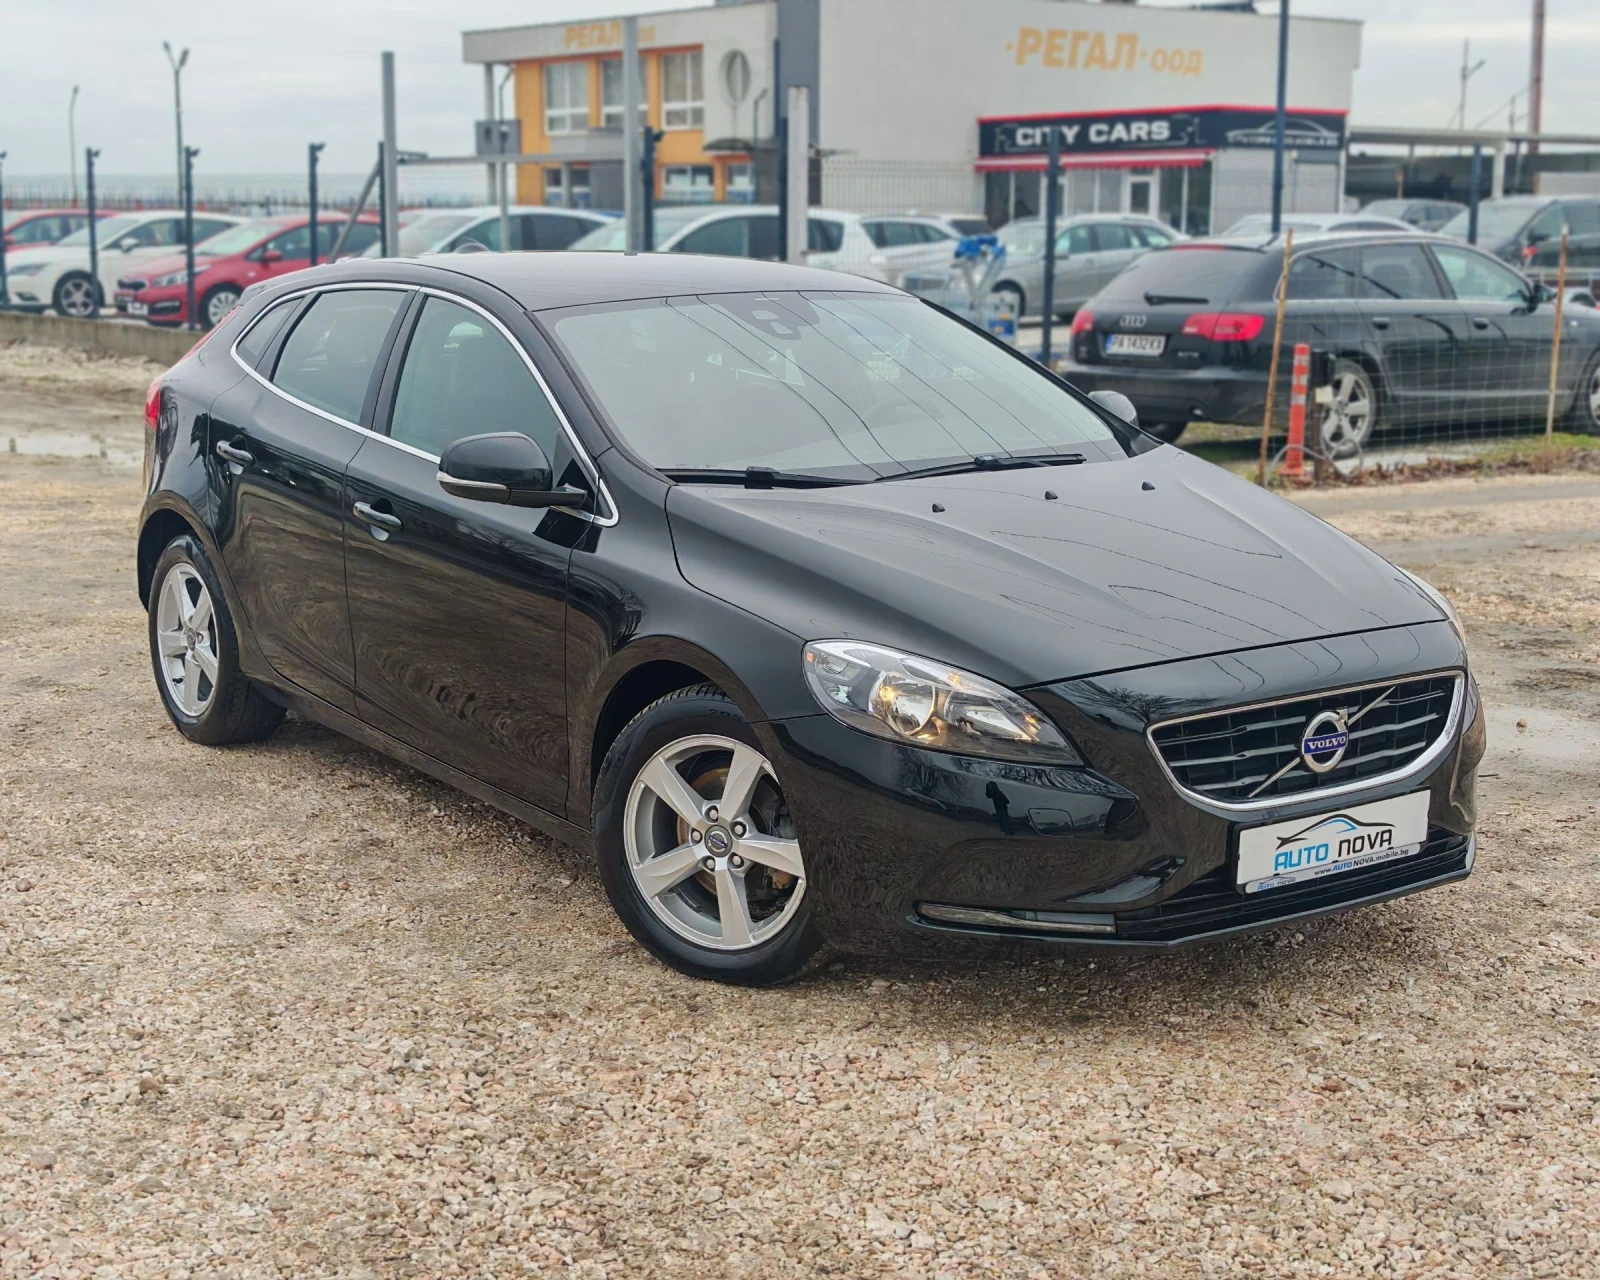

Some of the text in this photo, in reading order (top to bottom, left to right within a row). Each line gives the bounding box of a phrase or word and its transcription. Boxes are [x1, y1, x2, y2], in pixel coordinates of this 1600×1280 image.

[1088, 120, 1170, 143] CARS
[1307, 736, 1346, 750] VOLVO
[1274, 829, 1393, 871] AUTO NOVA
